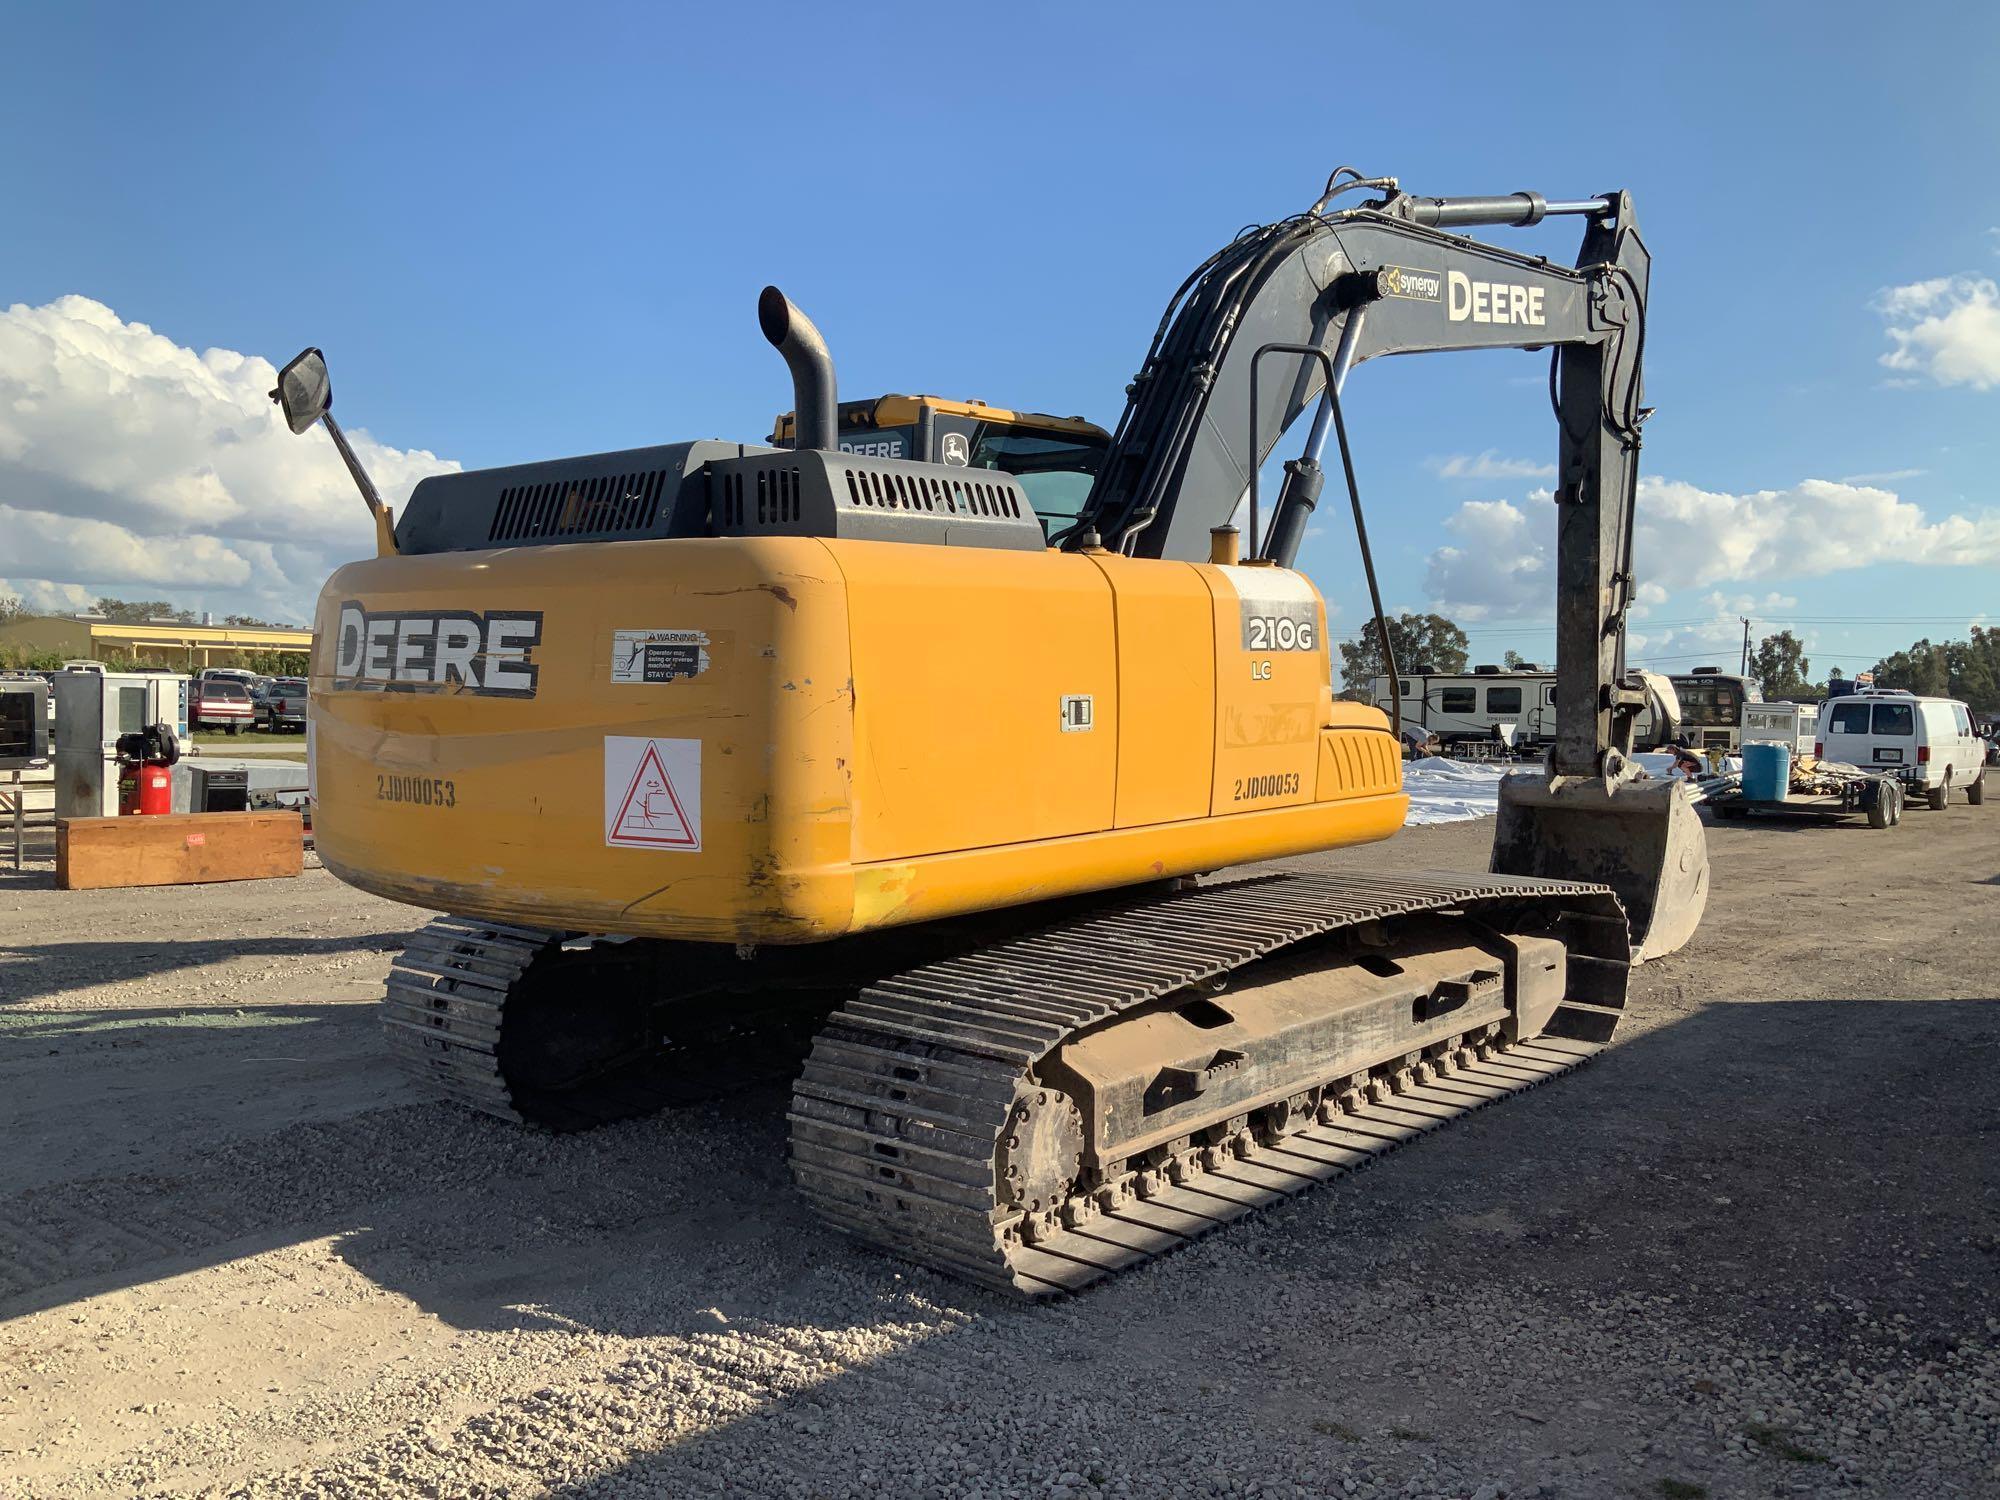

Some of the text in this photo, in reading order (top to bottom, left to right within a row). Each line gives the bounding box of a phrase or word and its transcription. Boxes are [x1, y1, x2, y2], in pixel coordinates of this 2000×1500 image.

[1400, 274, 1440, 297] synergy
[1448, 271, 1546, 325] DEERE
[657, 633, 697, 641] WARNING
[1248, 616, 1313, 651] 210G
[334, 604, 541, 694] DEERE
[1252, 661, 1272, 680] LC
[377, 775, 456, 807] 2JD00053
[1234, 773, 1299, 801] 2JD00053
